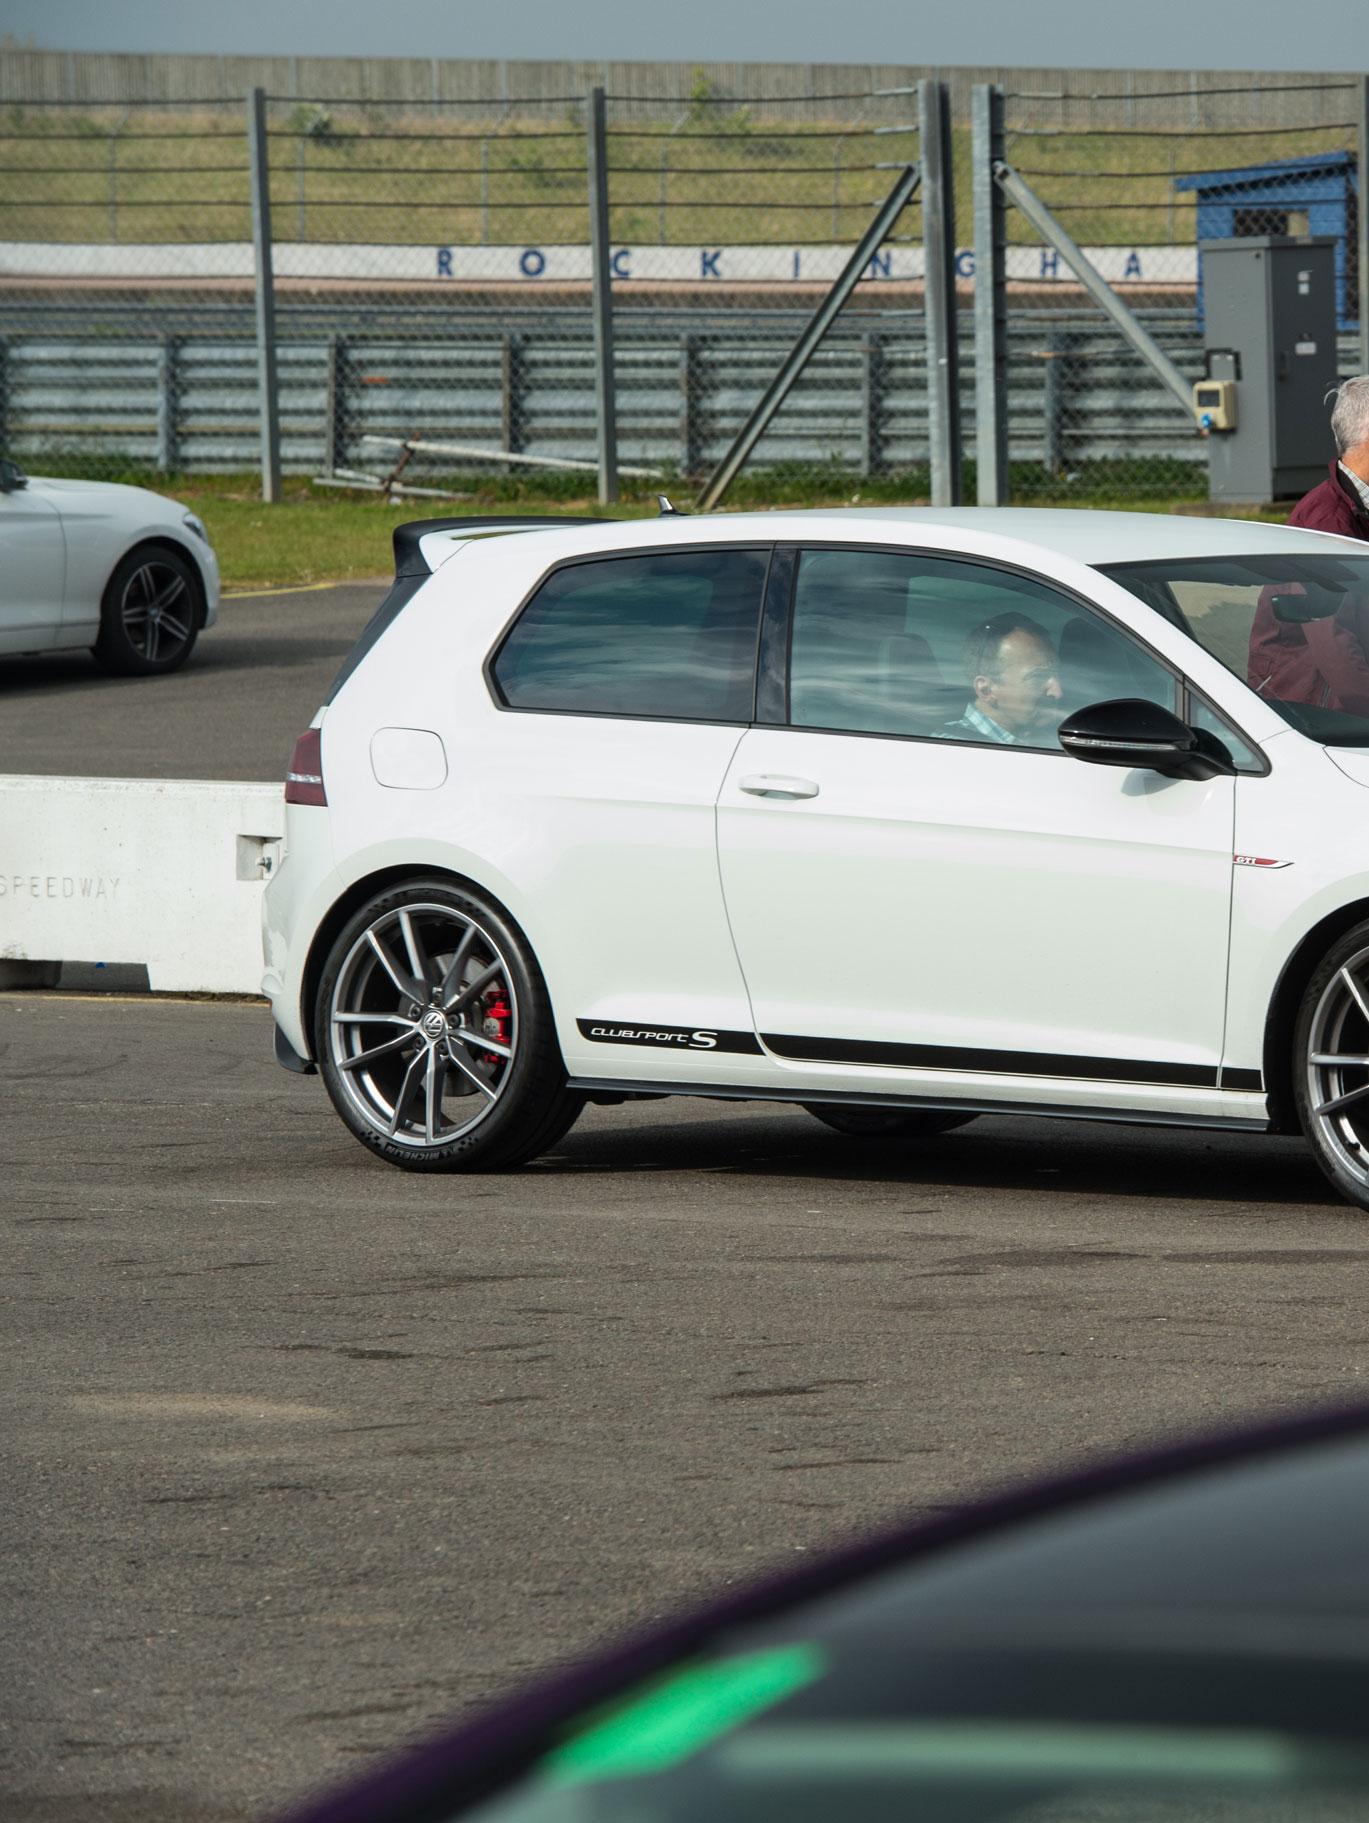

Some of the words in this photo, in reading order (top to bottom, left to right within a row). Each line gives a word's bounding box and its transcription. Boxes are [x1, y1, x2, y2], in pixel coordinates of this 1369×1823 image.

[437, 249, 1142, 279] ROCKINGHA
[1236, 856, 1257, 865] GTI
[689, 1031, 718, 1049] S
